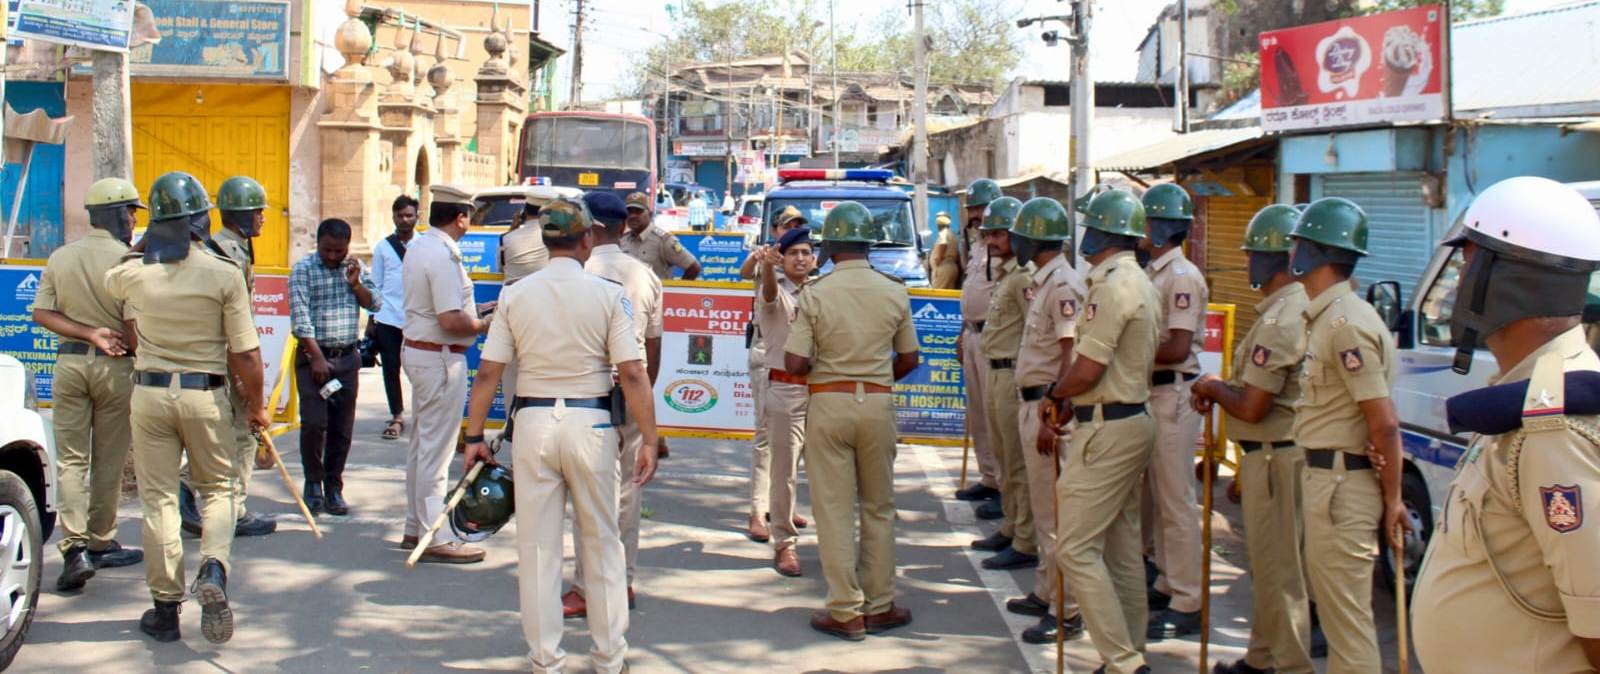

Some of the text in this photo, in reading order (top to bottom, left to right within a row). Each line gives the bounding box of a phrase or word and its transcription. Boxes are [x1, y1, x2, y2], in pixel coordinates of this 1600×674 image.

[175, 16, 198, 28] Stall
[210, 18, 249, 29] General
[251, 19, 278, 30] Store
[33, 338, 59, 350] KLE
[930, 370, 961, 383] KLE
[682, 389, 704, 401] 112
[910, 395, 967, 409] HOSPITAL
